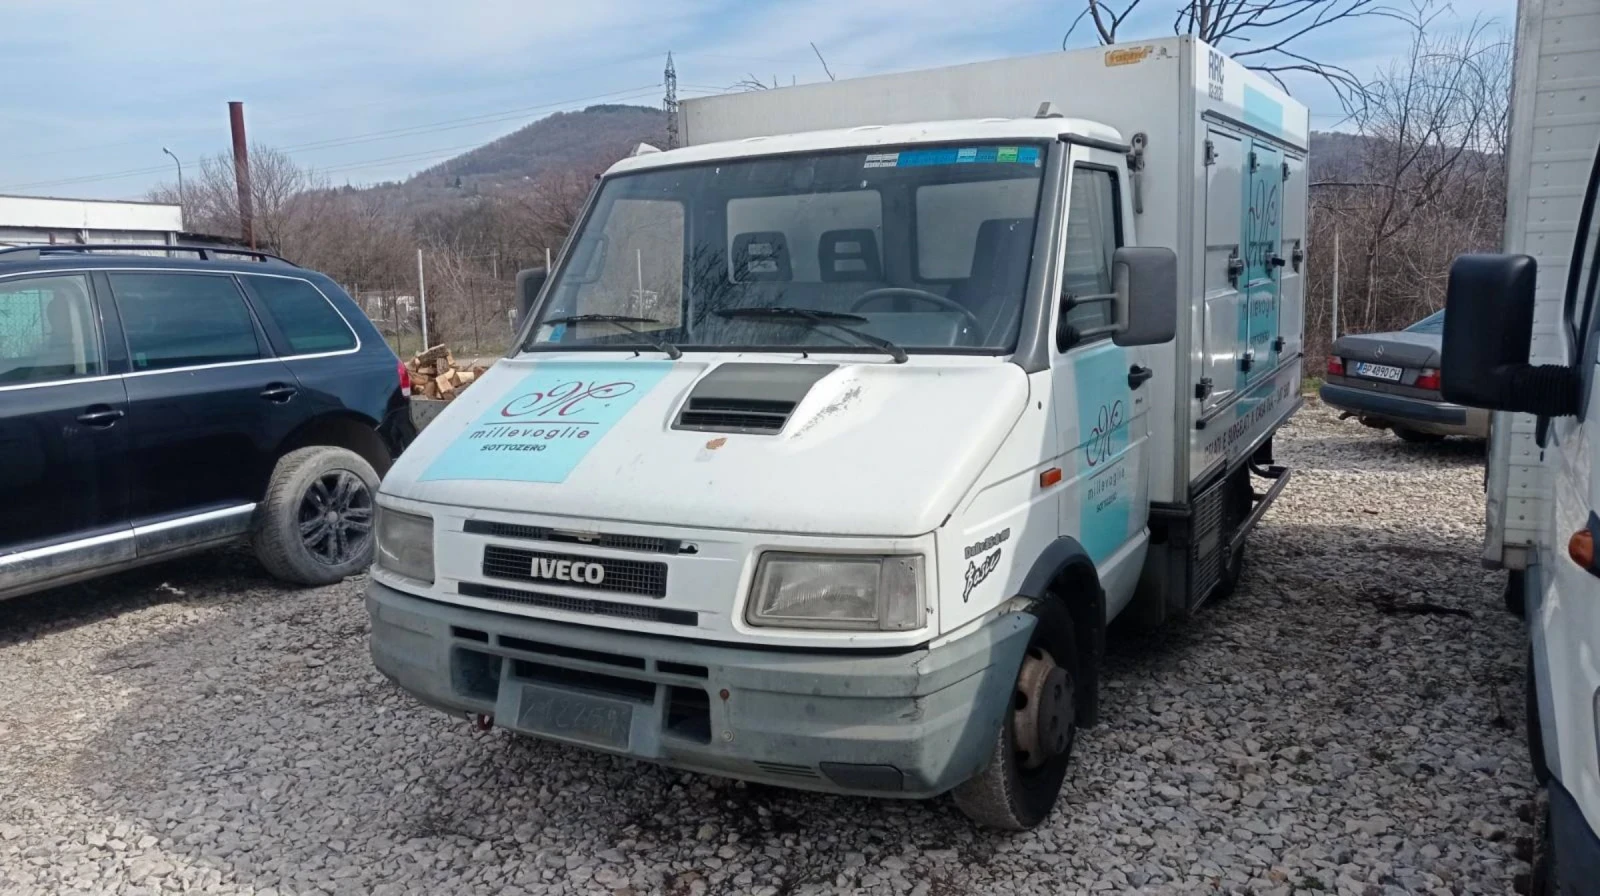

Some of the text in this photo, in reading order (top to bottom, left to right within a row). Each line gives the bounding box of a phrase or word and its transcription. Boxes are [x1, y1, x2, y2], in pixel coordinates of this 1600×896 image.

[1208, 50, 1224, 84] RRC
[1372, 366, 1389, 377] 4890
[1389, 368, 1400, 379] CH
[470, 425, 590, 441] millevoglie
[480, 444, 547, 452] SOTTOZERO
[963, 540, 984, 560] Daily
[530, 557, 605, 585] IVECO
[962, 547, 1002, 604] Basic
